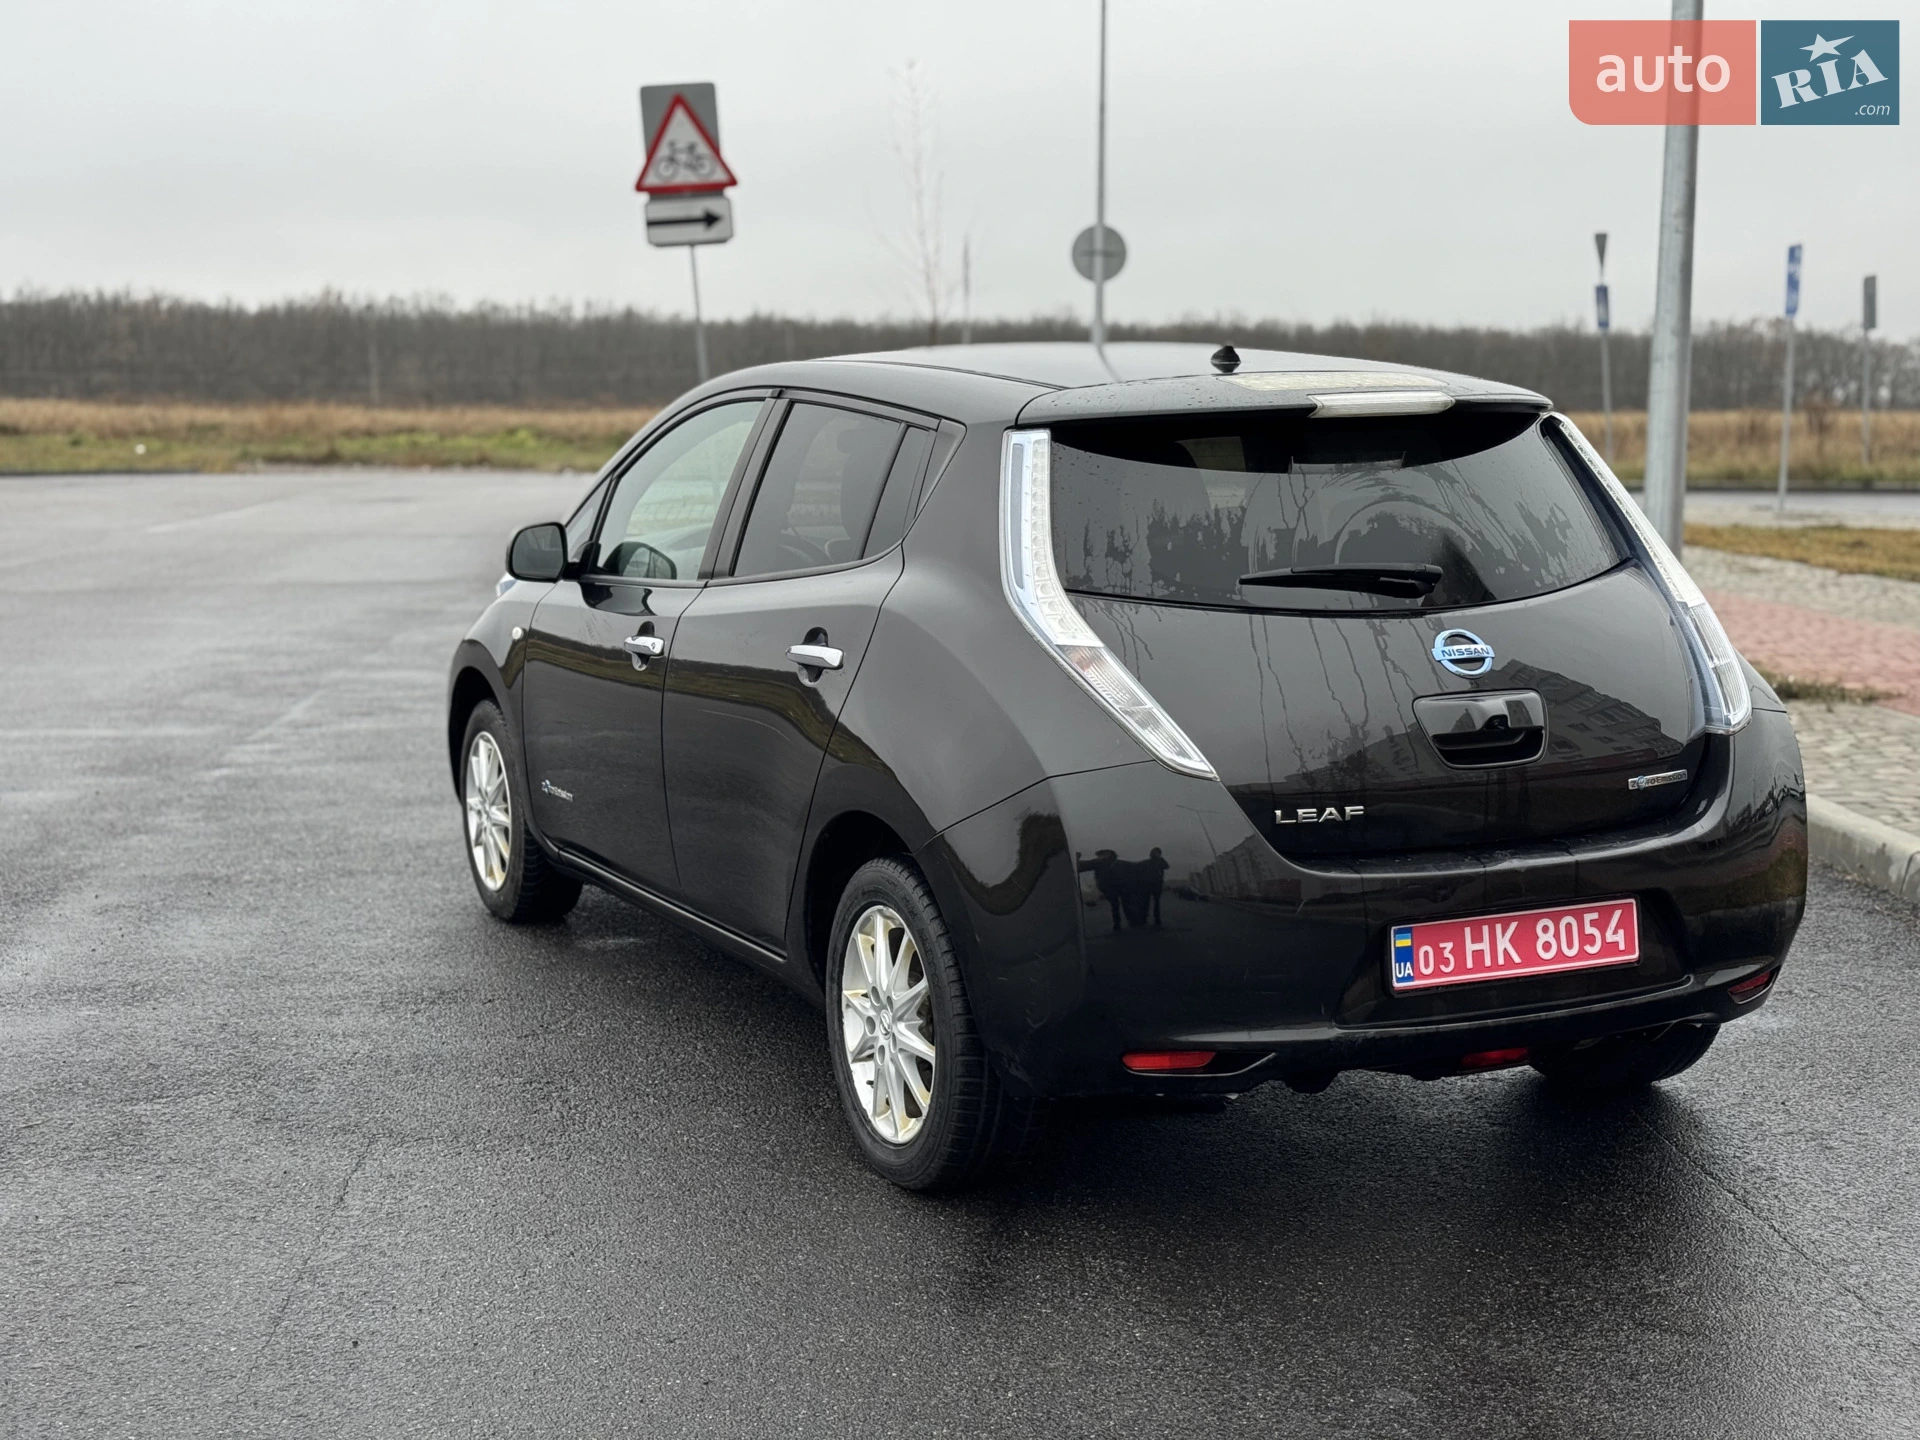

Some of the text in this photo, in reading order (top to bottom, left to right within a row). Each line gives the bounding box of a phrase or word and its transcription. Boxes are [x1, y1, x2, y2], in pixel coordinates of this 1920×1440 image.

[1441, 646, 1490, 658] NISSAN
[1274, 805, 1365, 824] LEAF
[1418, 909, 1626, 976] 03 HK 8054
[1395, 962, 1414, 978] UA
